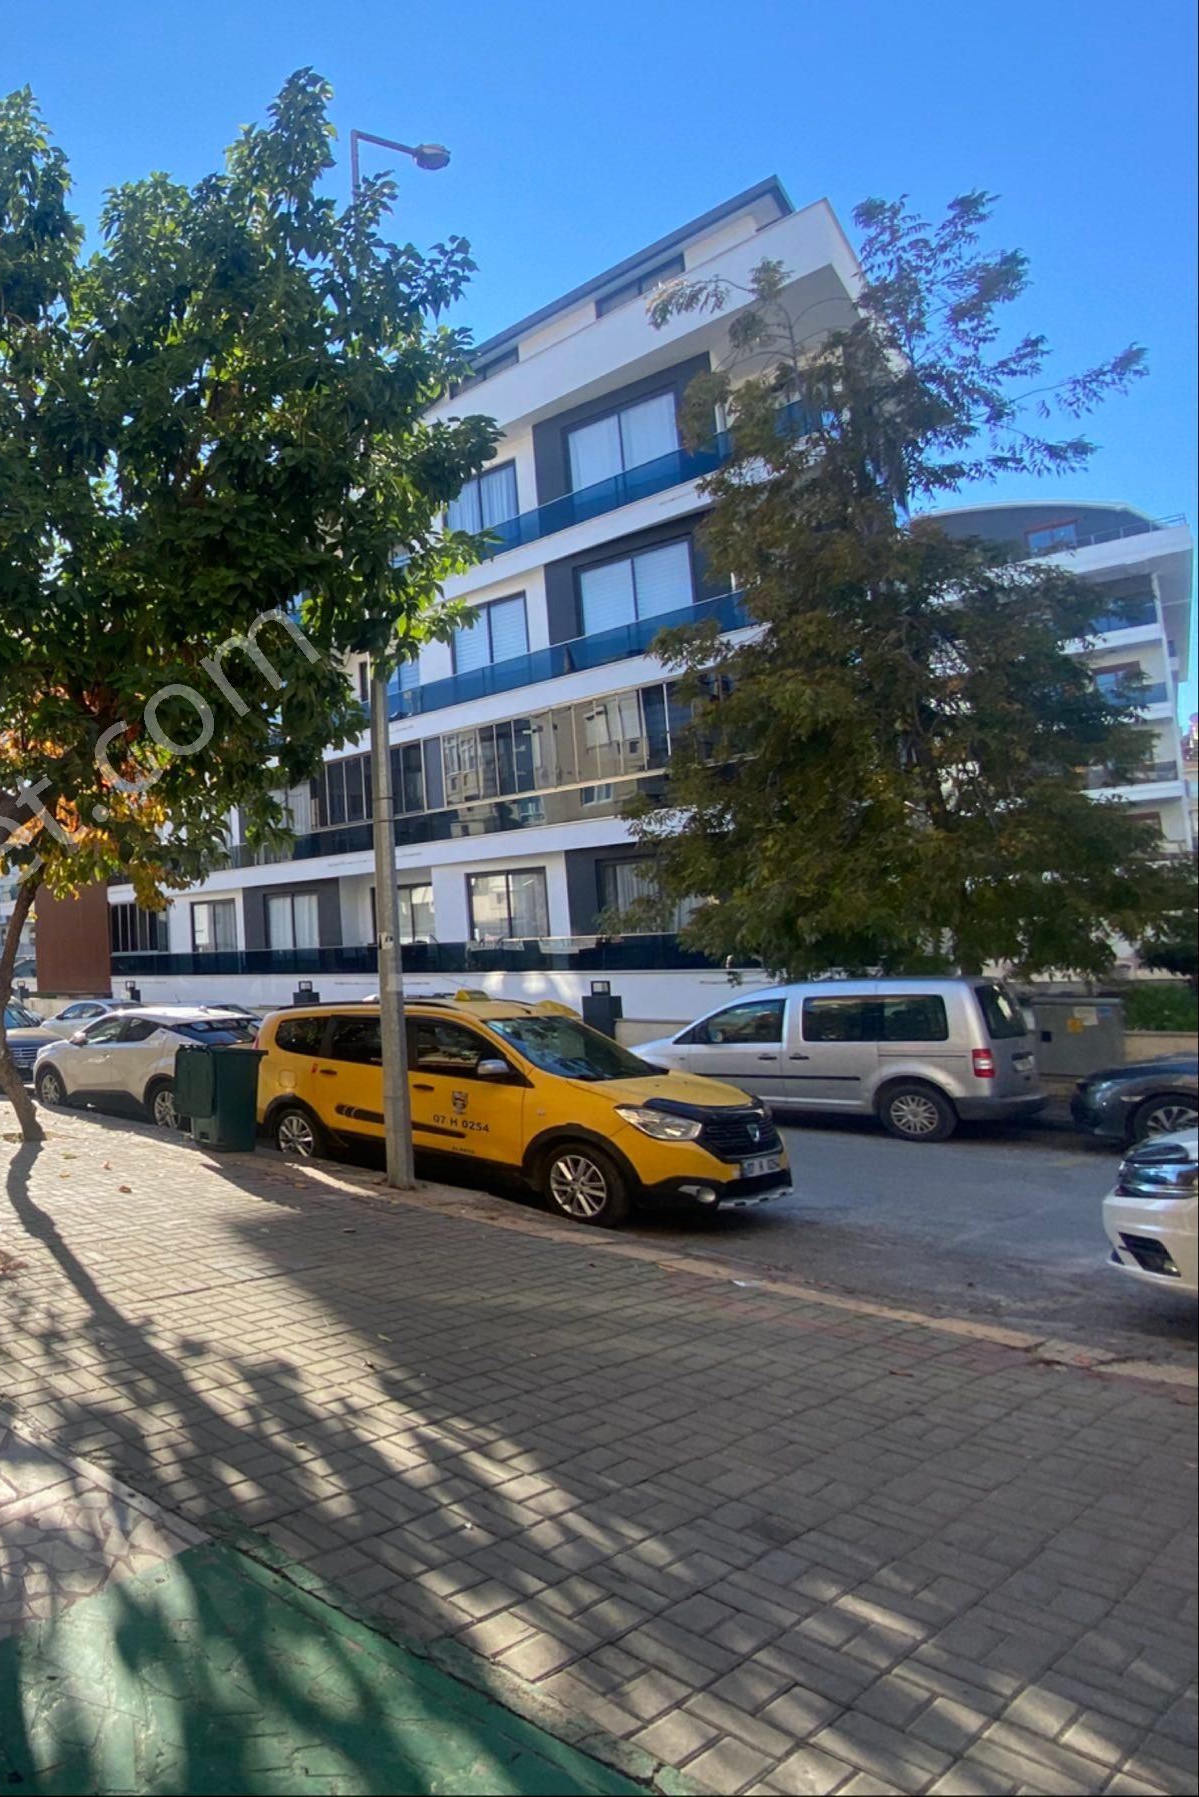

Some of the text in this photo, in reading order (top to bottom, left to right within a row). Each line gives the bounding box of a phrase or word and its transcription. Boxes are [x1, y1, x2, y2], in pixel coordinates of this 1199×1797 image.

[433, 1114, 490, 1133] 07 H 0254
